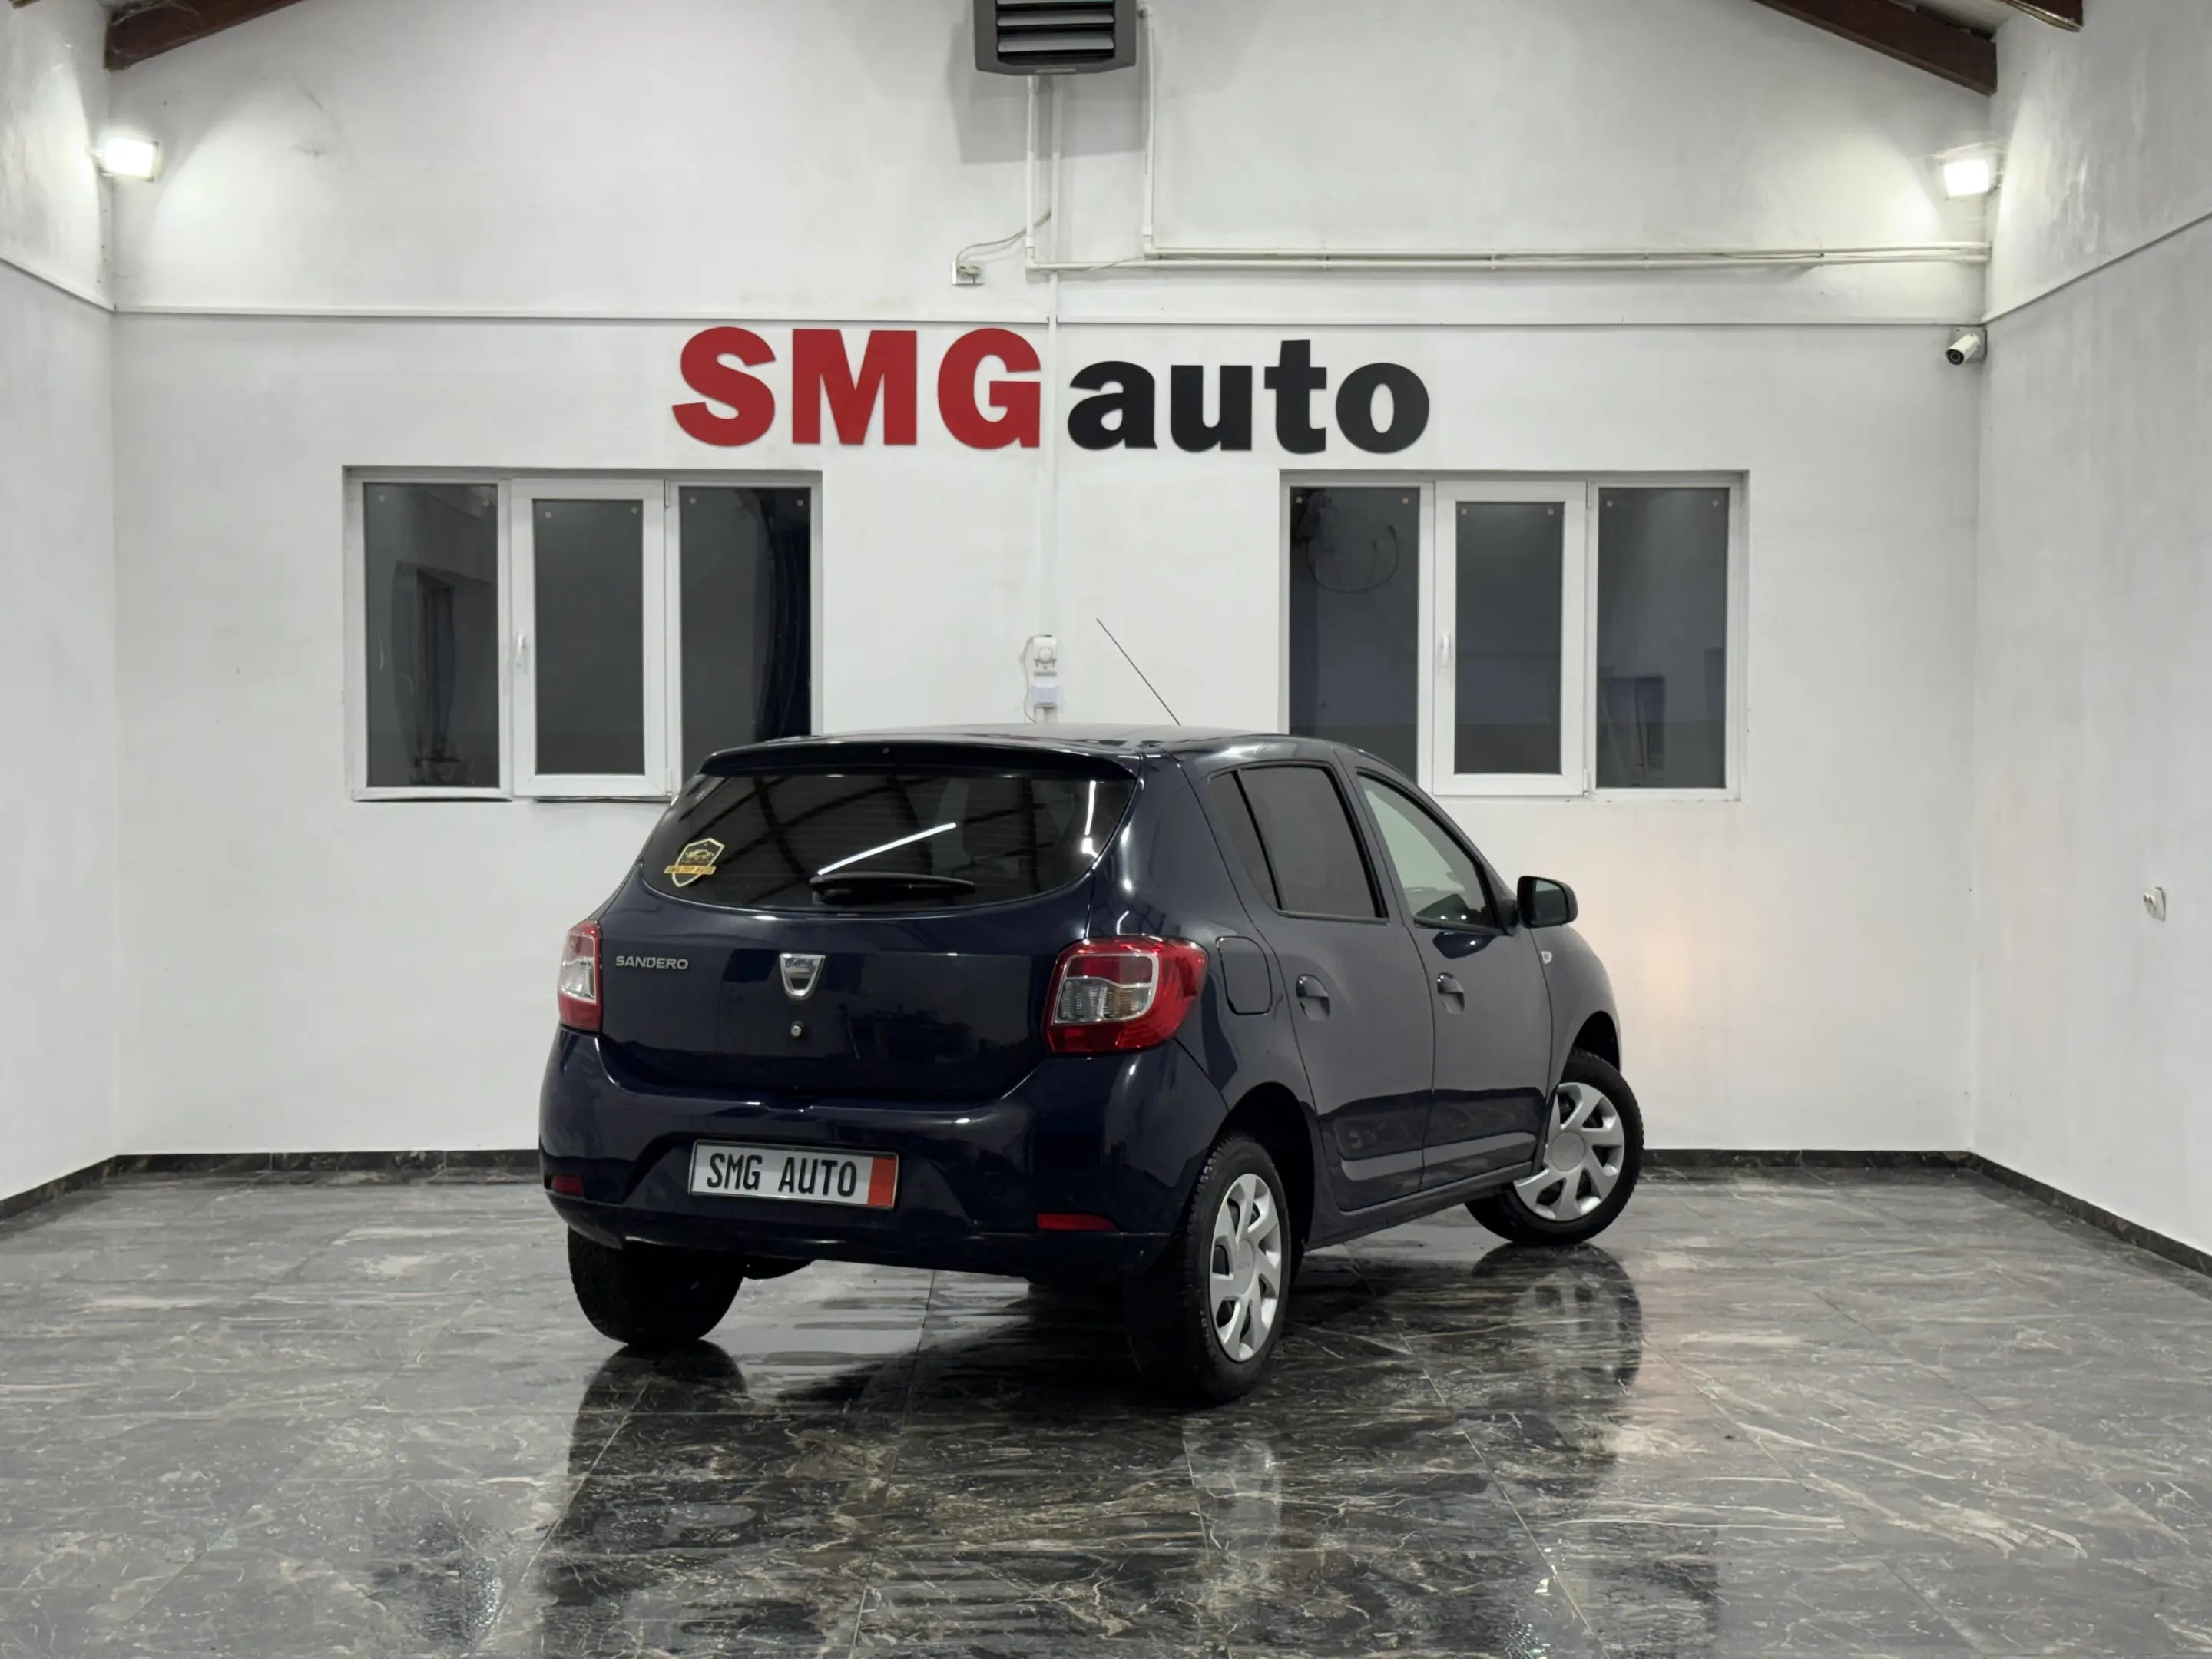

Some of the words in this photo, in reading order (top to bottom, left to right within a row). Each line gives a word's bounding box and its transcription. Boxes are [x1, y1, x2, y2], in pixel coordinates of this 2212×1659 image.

[615, 955, 689, 969] SANDERO
[707, 1153, 763, 1190] SMG
[777, 1156, 858, 1197] AUTO
